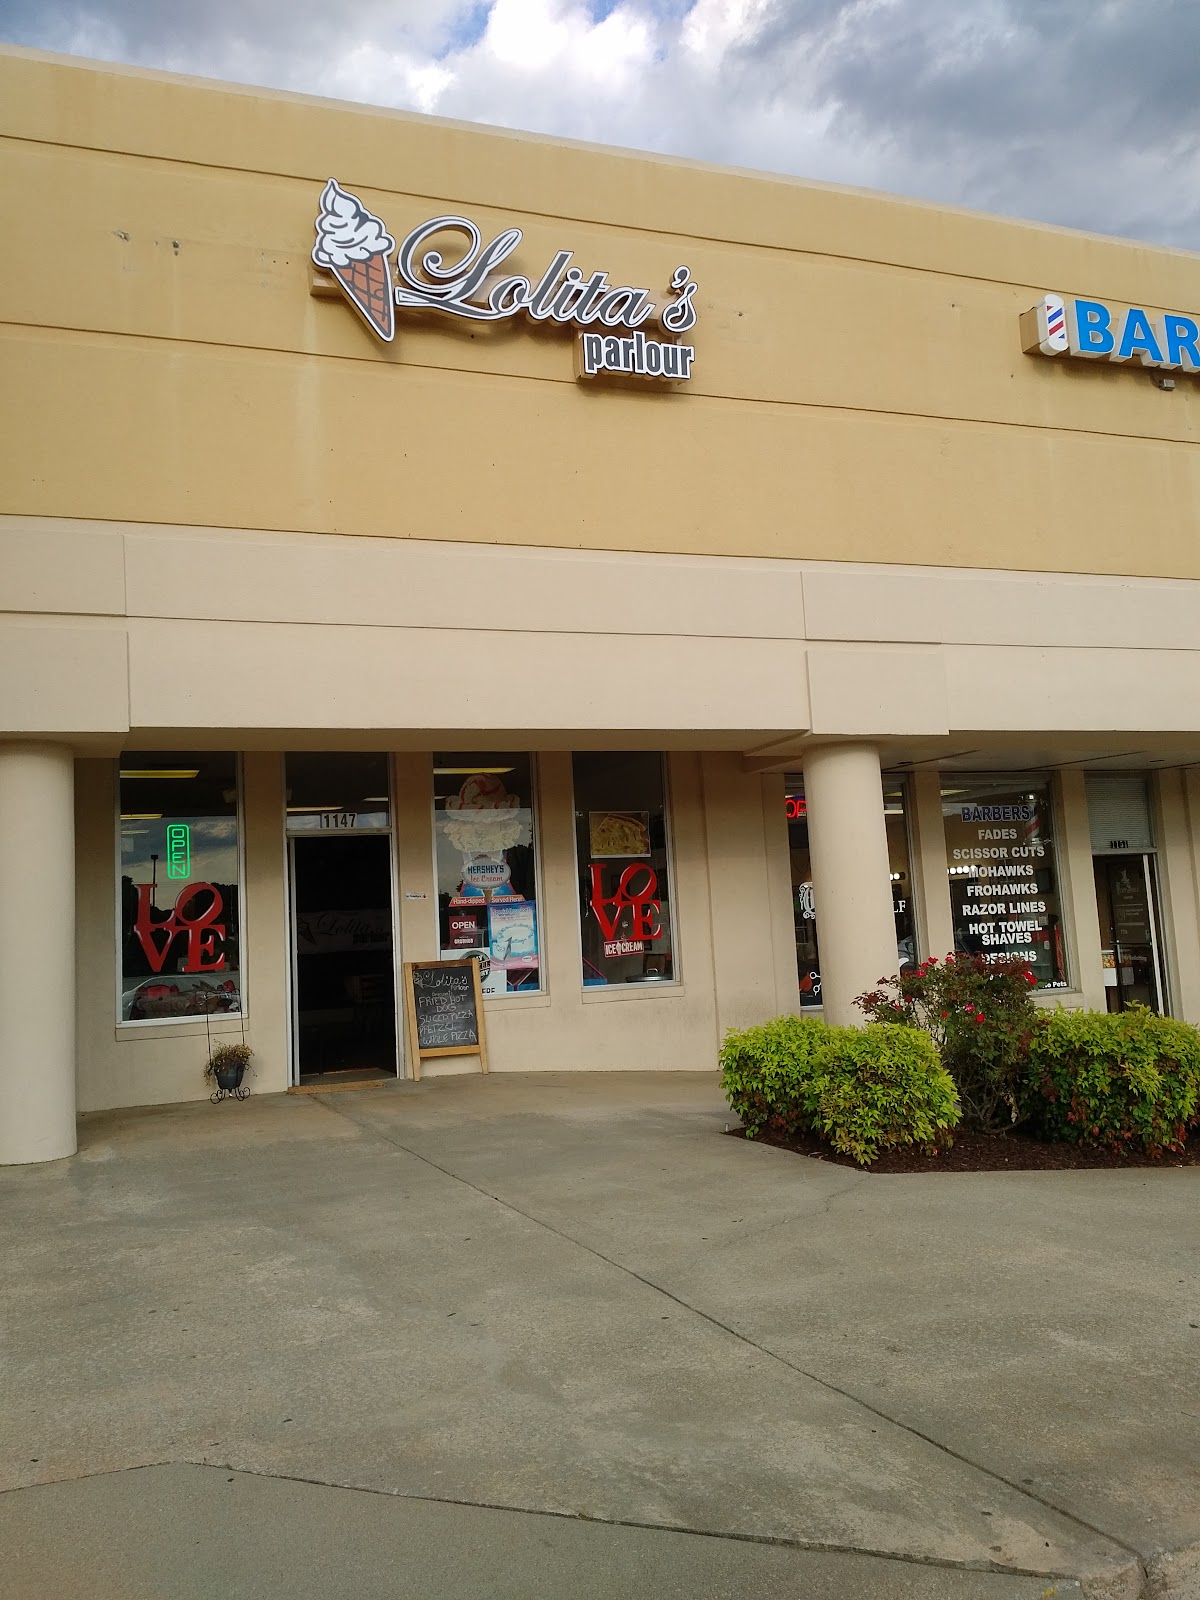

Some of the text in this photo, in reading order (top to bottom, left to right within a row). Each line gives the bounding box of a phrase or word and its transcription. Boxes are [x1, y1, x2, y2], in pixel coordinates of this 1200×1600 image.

[395, 215, 698, 332] Lolita's
[1074, 299, 1200, 368] BAR
[583, 332, 694, 379] parlour
[785, 800, 807, 817] OP
[962, 805, 1030, 822] BARBERS
[324, 814, 355, 828] 1147
[978, 829, 1017, 840] FADES
[172, 829, 185, 876] OPEN
[953, 846, 1045, 859] SCISSOR CUTS
[467, 865, 504, 874] HERSHEY'S
[968, 865, 1034, 878] MOHAWKS
[967, 883, 1038, 897] FROHAWKS
[962, 902, 1046, 916] RAZOR LINES
[452, 921, 475, 929] OPEN
[969, 920, 1042, 934] HOT TOWEL
[982, 932, 1032, 946] SHAVES
[605, 941, 643, 955] ICE CREAM
[418, 996, 448, 1007] FRIED
[436, 1004, 457, 1013] DOG
